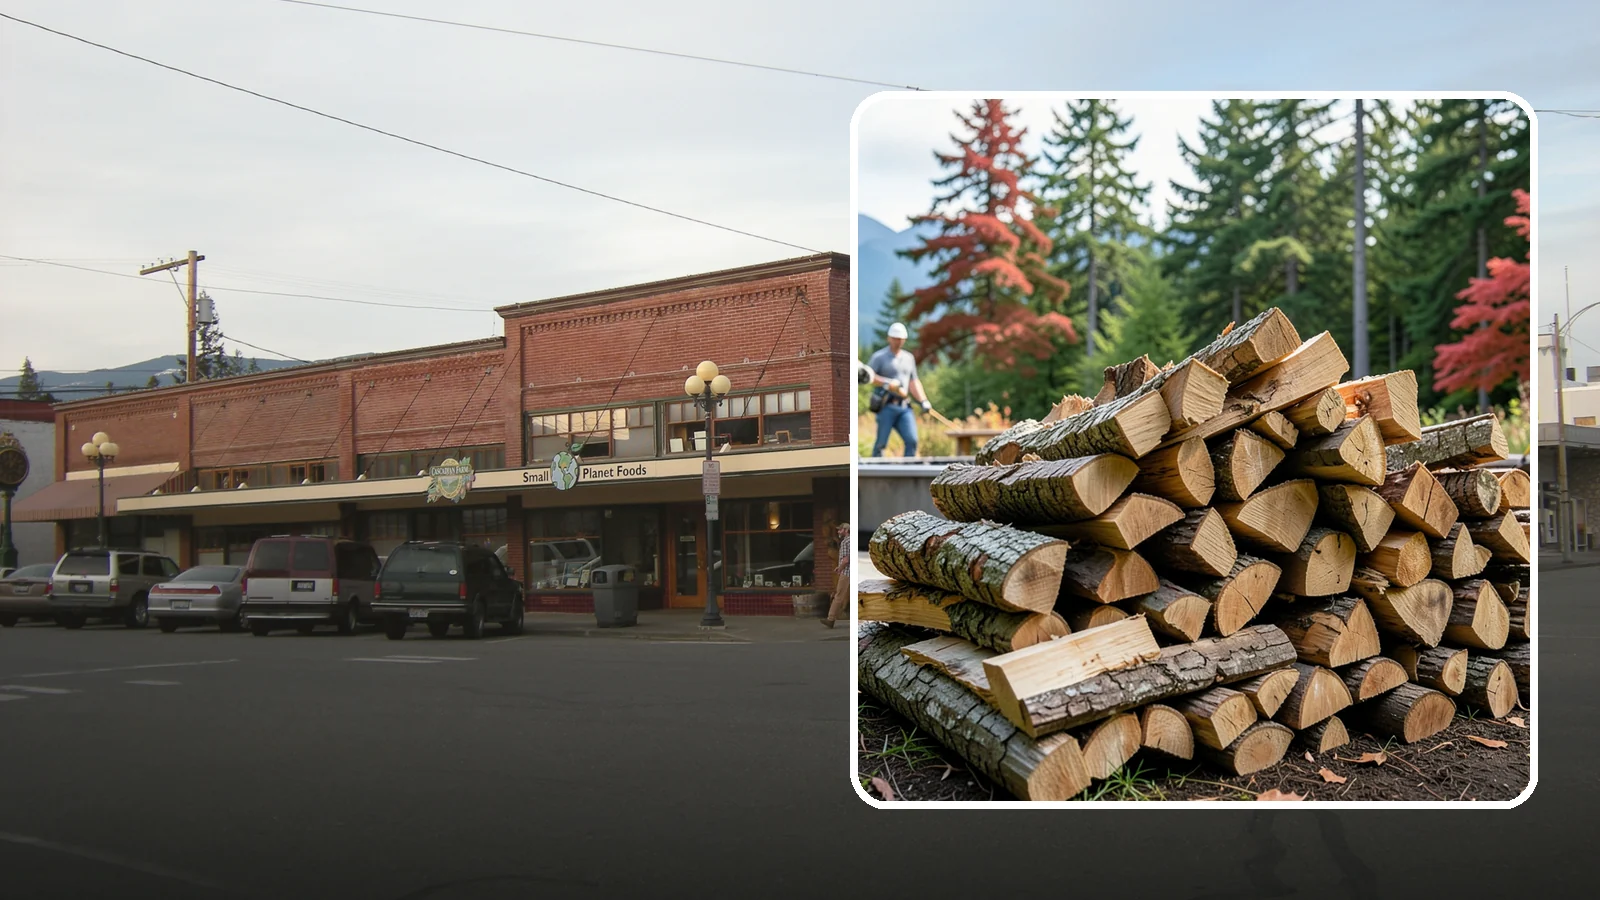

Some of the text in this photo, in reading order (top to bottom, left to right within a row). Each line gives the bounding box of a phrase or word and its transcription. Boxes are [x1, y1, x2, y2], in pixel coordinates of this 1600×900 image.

[523, 464, 647, 483] Small Planet Foods
